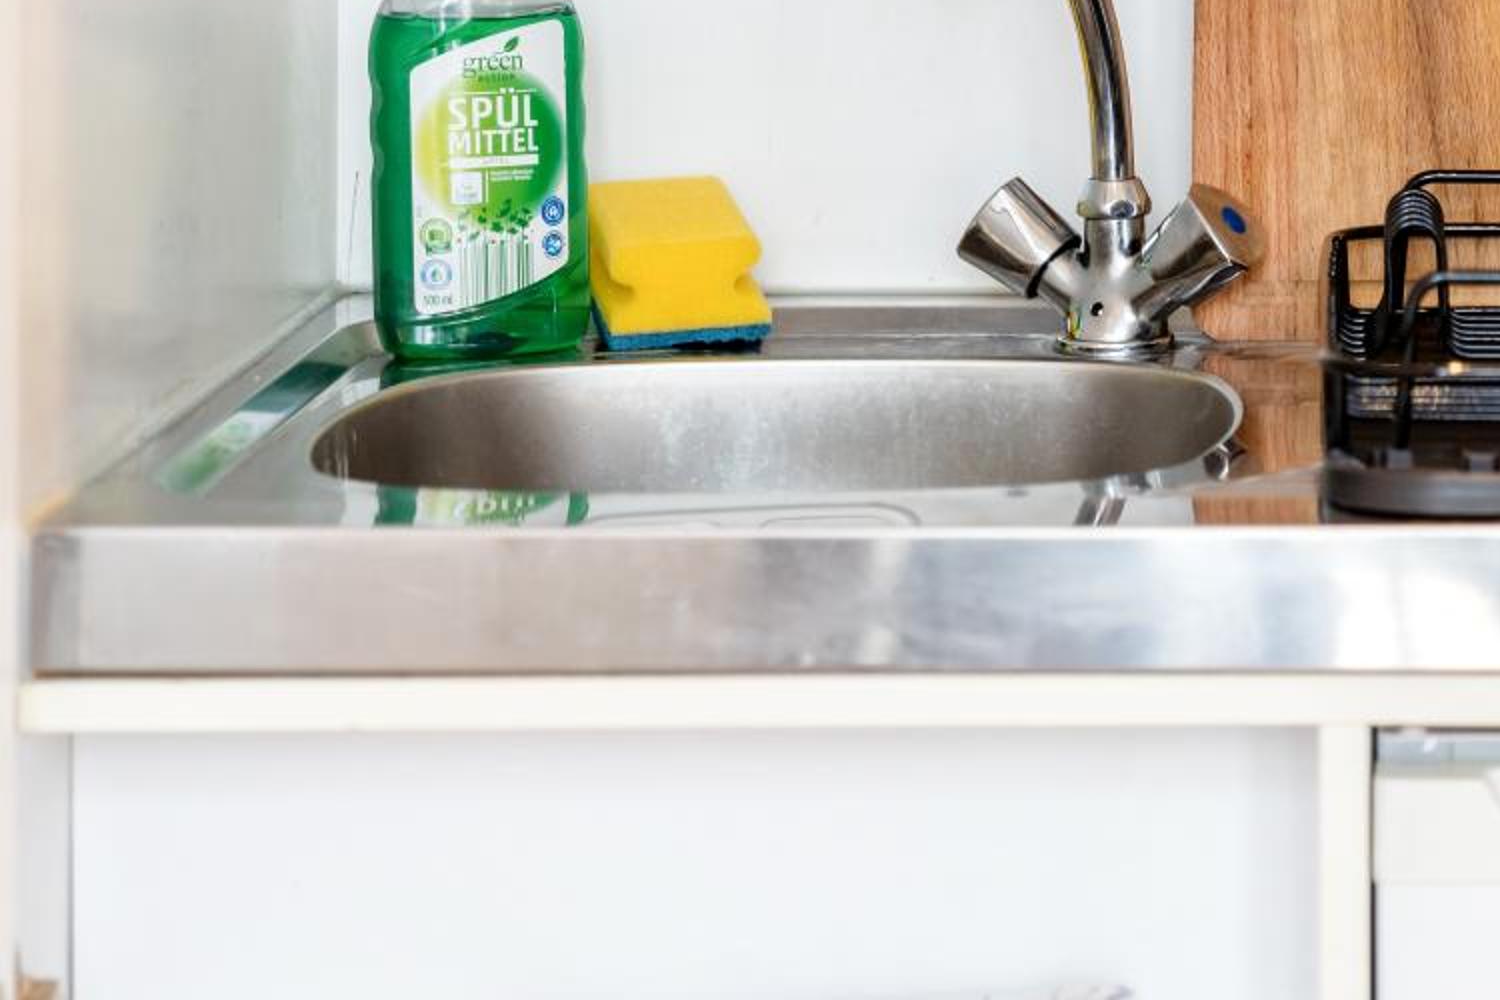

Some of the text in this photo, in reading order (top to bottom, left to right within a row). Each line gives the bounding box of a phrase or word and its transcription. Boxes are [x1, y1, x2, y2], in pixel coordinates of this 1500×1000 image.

[462, 53, 524, 79] green
[448, 88, 539, 131] SPÜL
[448, 128, 539, 155] MITTEL
